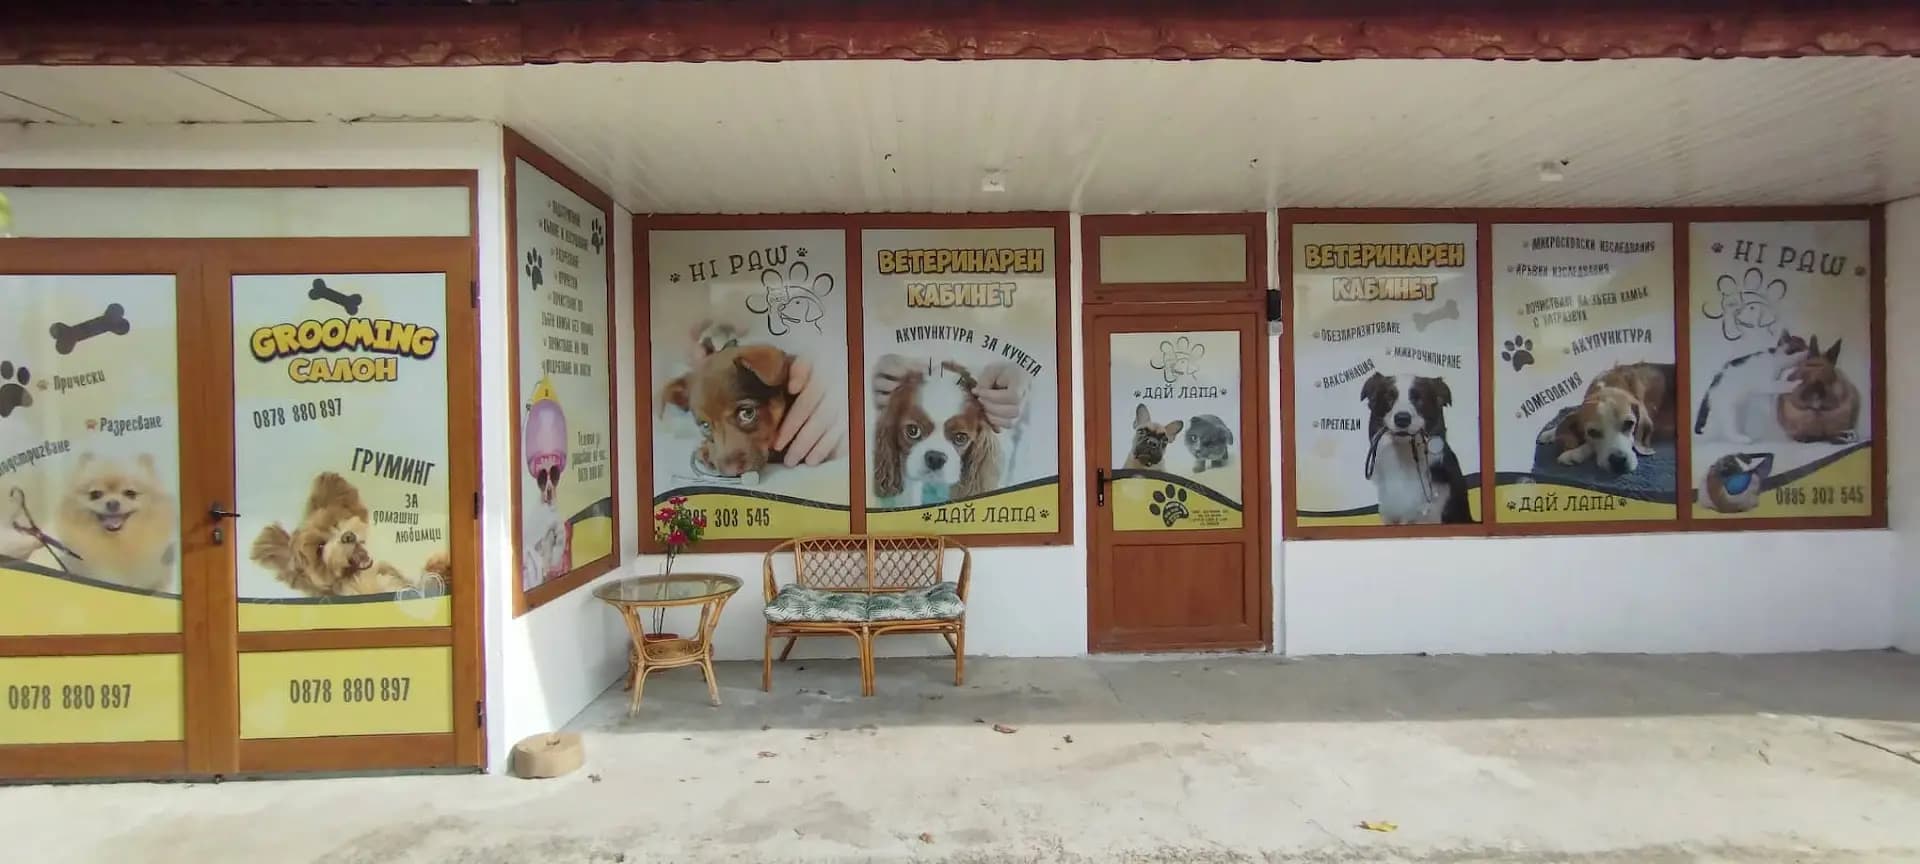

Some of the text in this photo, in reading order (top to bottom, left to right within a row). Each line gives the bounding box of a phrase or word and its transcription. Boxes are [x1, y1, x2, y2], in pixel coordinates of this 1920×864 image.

[689, 245, 789, 283] HI PAW
[878, 248, 1044, 274] ВЕТЕРИНАРЕН
[1305, 243, 1465, 269] ВЕТЕРИНАРЕН
[1733, 240, 1848, 277] HI PAW
[907, 282, 1017, 308] КАБИНЕТ
[1332, 275, 1438, 302] КАБИНЕТ
[250, 317, 439, 362] GROOMING
[1321, 322, 1400, 342] ОБЕЗПАРАЗИТЯВАНЕ
[1571, 328, 1652, 356] АКУПУНКТУРА
[896, 325, 1043, 377] АКУПУНКТУРА ЗА КУЧЕТА
[1393, 347, 1462, 369] МИКРОЧИПИРАНЕ
[53, 369, 106, 394] Прически
[288, 357, 398, 384] САЛОН
[1322, 358, 1376, 389] ВАКСИНАЦИЯ
[1142, 384, 1218, 400] ДАЙ ЛАПА
[1520, 371, 1584, 419] ХОМЕОПАТИЯ
[100, 415, 163, 436] Разресване
[253, 398, 343, 429] 0878 880 897
[1320, 418, 1361, 431] ПРЕГЛЕДИ
[351, 447, 436, 486] ГРУМИНГ
[405, 493, 418, 509] ЗА
[1518, 491, 1616, 513] ДАЙ ЛАПА
[715, 508, 738, 528] 303
[746, 507, 770, 527] 545
[934, 505, 1037, 524] ДАЙ ЛАПА
[8, 684, 132, 710] 0878 880 897
[290, 677, 411, 704] 0878 880 897
